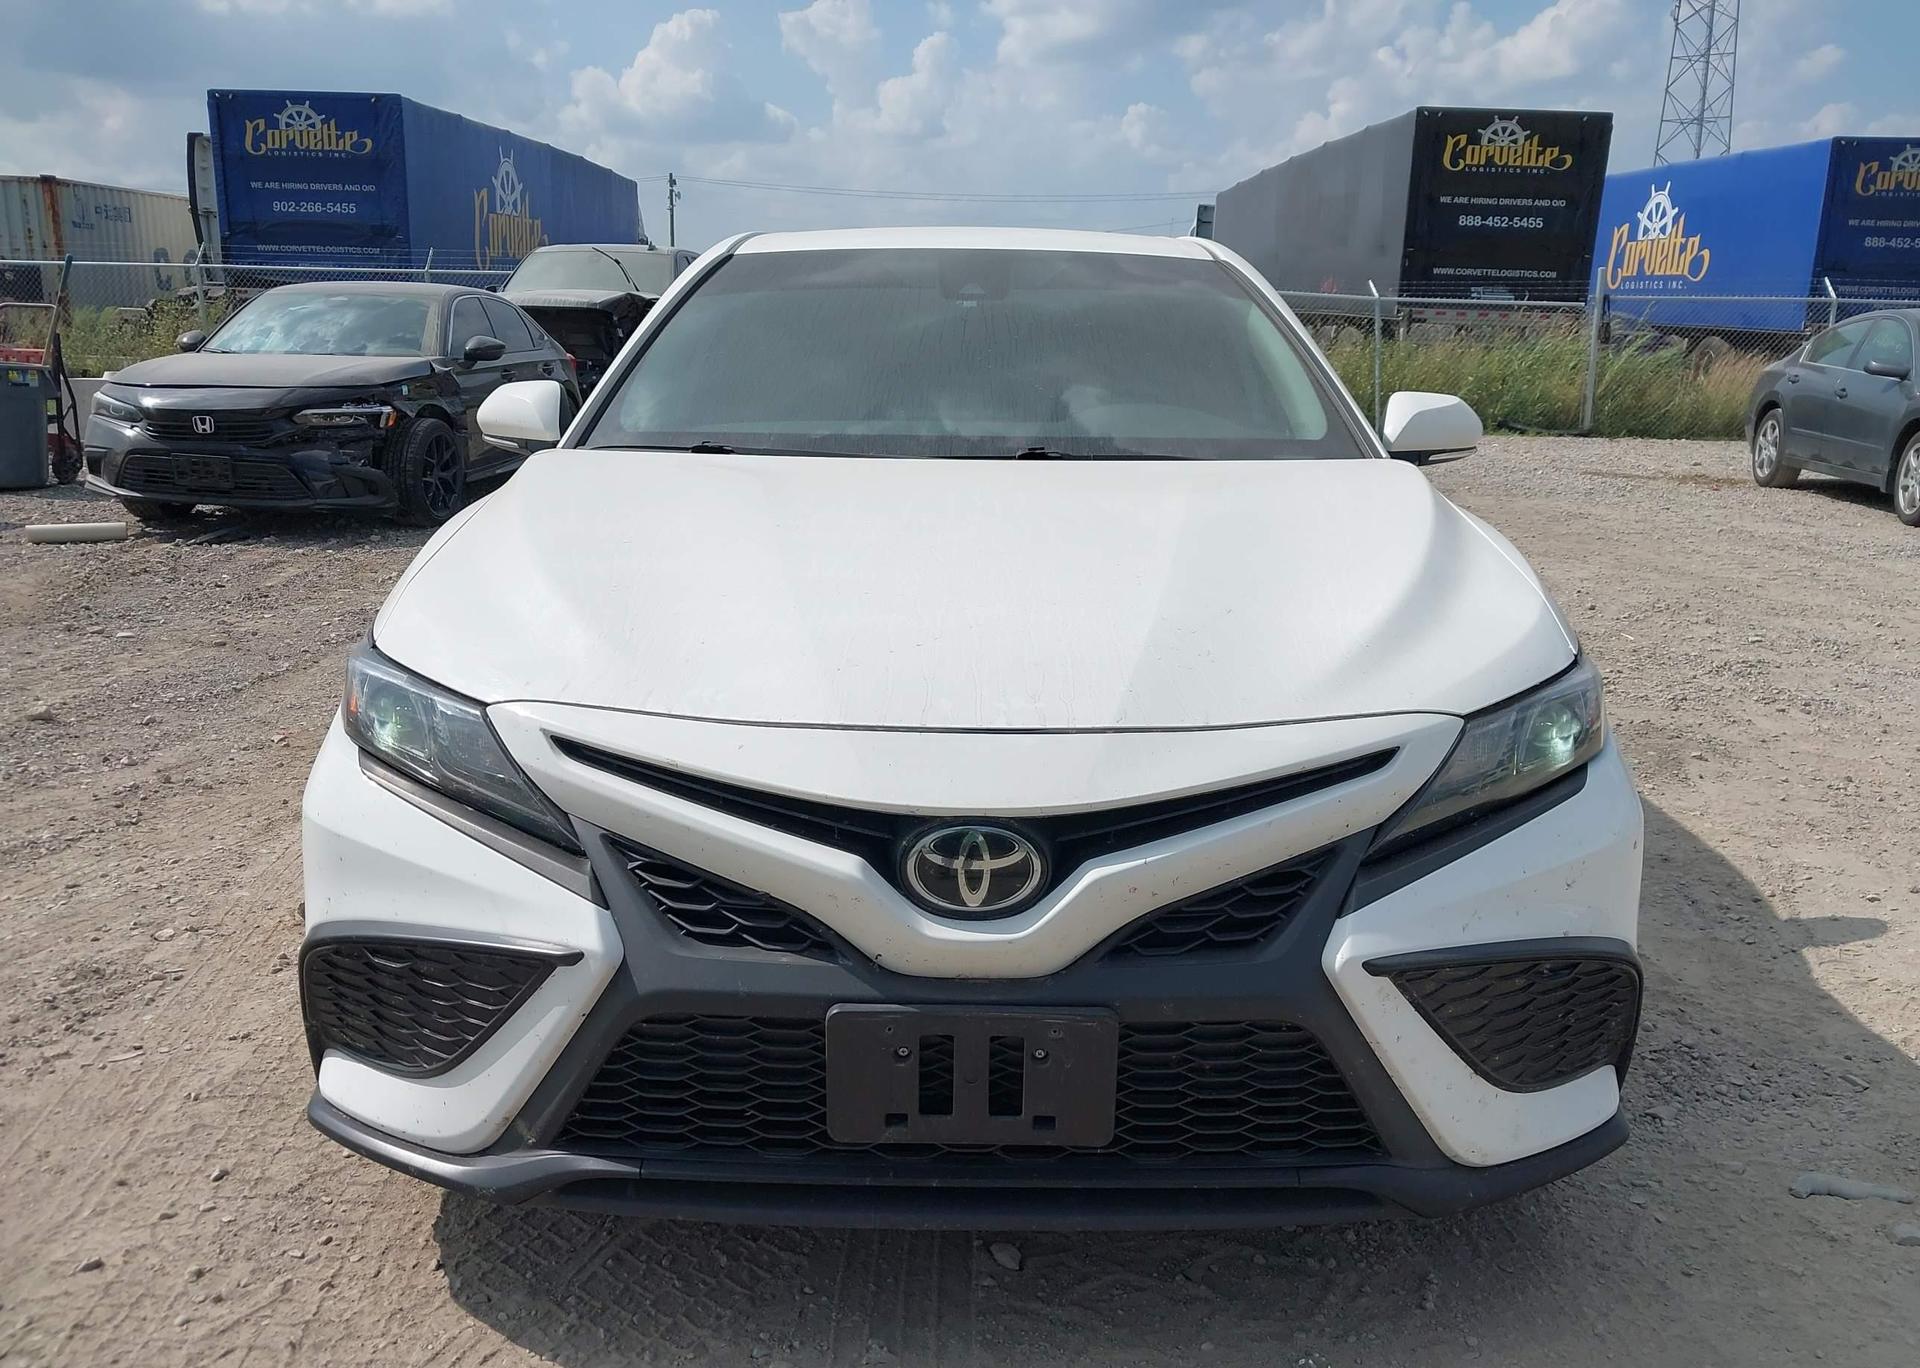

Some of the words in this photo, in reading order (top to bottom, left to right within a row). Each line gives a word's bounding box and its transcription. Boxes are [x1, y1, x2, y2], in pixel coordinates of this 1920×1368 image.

[245, 118, 372, 155] Corvette
[1443, 133, 1573, 171] Corvette
[1855, 160, 1920, 196] Corv
[250, 181, 263, 189] WE
[281, 183, 309, 191] HIRING
[310, 184, 343, 192] DRIVERS
[272, 201, 357, 214] 902-266-5455
[1440, 196, 1453, 204] WE
[1453, 196, 1470, 204] ARE
[1470, 197, 1498, 205] HIRING
[1499, 198, 1533, 206] DRIVERS
[1458, 214, 1544, 228] 888-452-5455
[256, 244, 380, 254] WWW.CORVETTELOGISTICS.COM
[1607, 212, 1710, 289] Corvette
[1432, 267, 1557, 278] WWW.CORVETTELOGISTICS.COM
[1620, 281, 1664, 290] LOGISTICS
[1668, 281, 1688, 289] INC.
